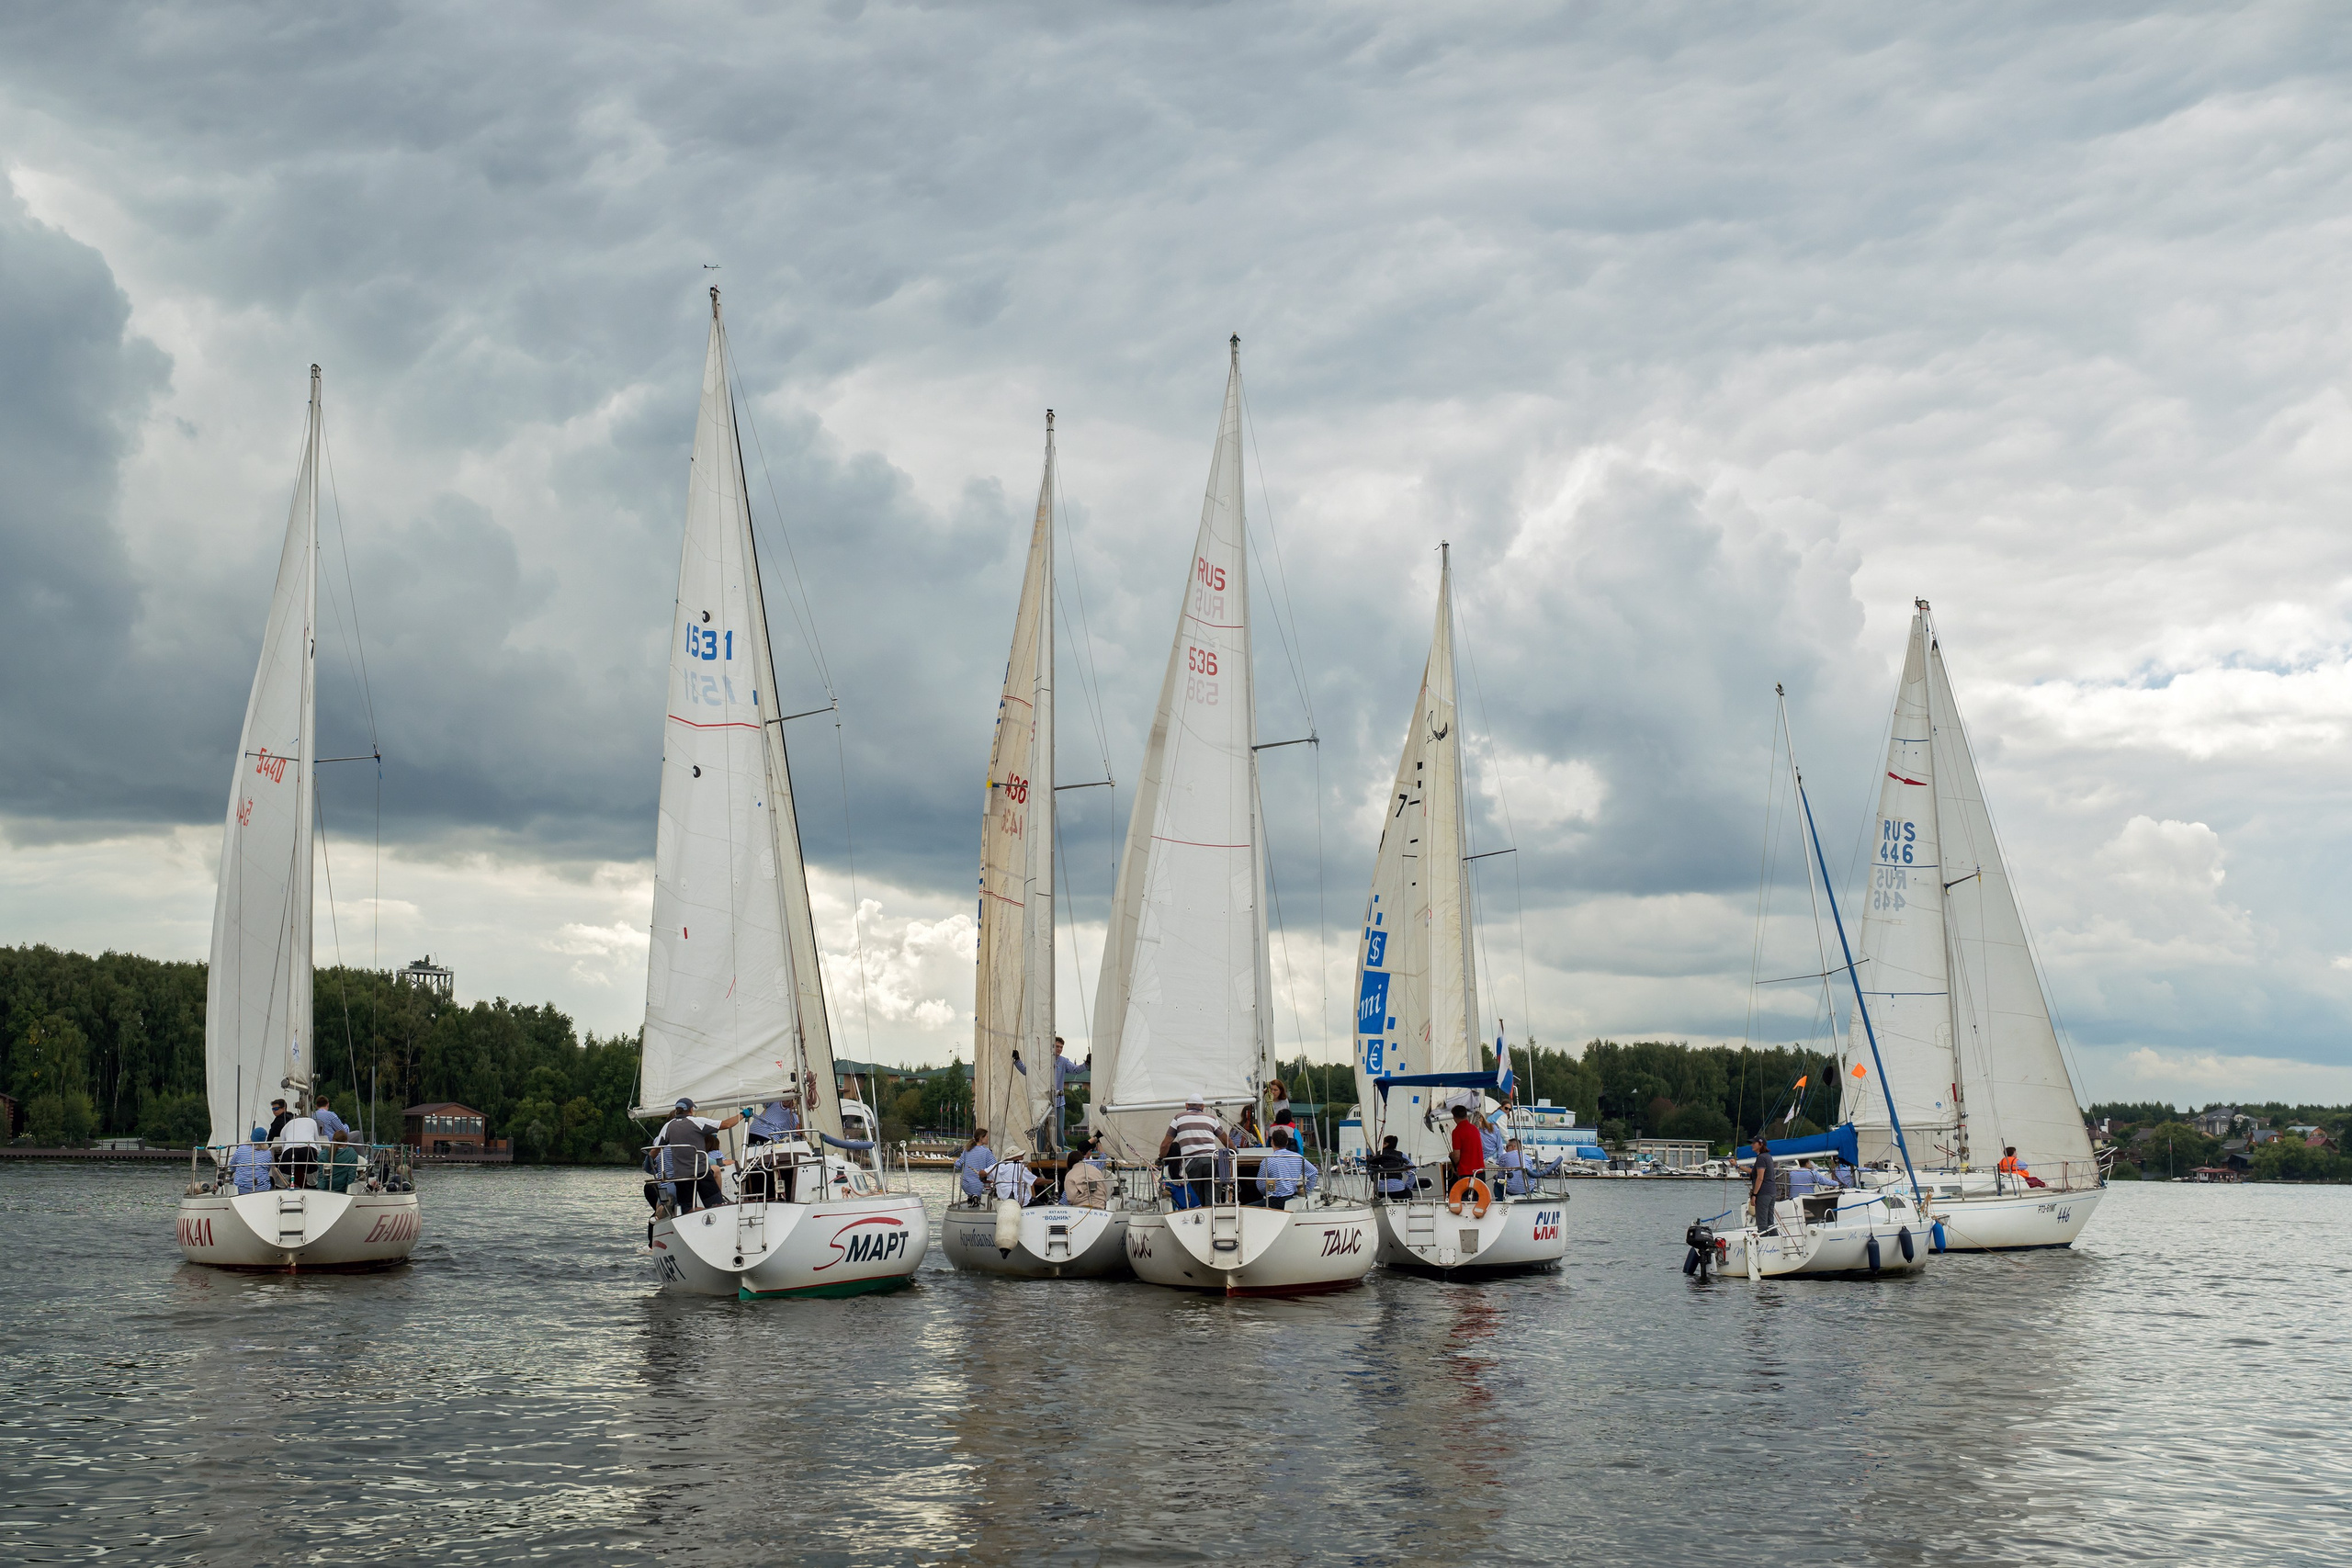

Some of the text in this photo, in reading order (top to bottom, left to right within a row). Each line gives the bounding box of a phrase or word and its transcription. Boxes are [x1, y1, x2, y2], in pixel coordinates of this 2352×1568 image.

[1197, 557, 1226, 591] RUS
[685, 622, 732, 660] 1531
[1189, 646, 1218, 676] 536
[256, 747, 287, 784] 5440
[1883, 819, 1916, 842] RUS
[1880, 842, 1914, 863] 446
[1360, 984, 1382, 1021] mi
[1533, 1211, 1560, 1241] СКАТ
[2057, 1206, 2071, 1224] 446
